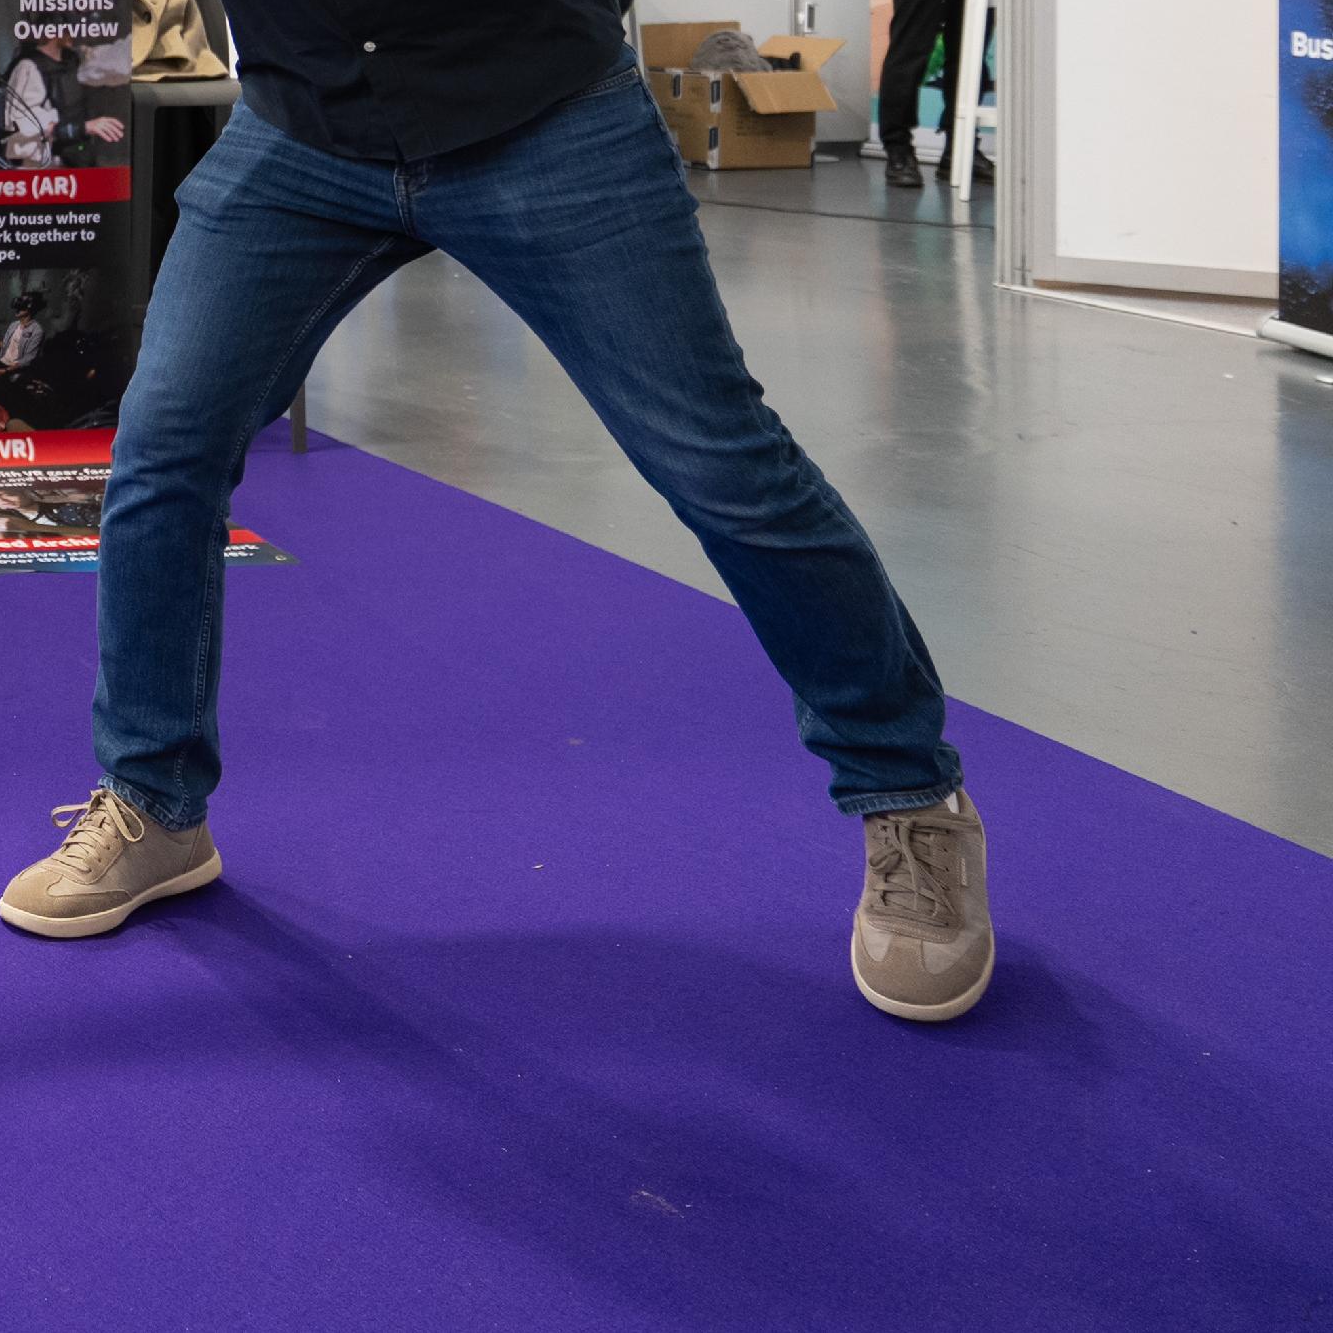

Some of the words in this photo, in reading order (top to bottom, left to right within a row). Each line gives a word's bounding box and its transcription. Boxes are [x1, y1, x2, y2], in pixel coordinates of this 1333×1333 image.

[14, 17, 119, 40] Overview
[31, 174, 78, 201] (AR)
[9, 212, 52, 225] house
[56, 211, 101, 225] where
[15, 229, 78, 245] together
[80, 229, 96, 241] to
